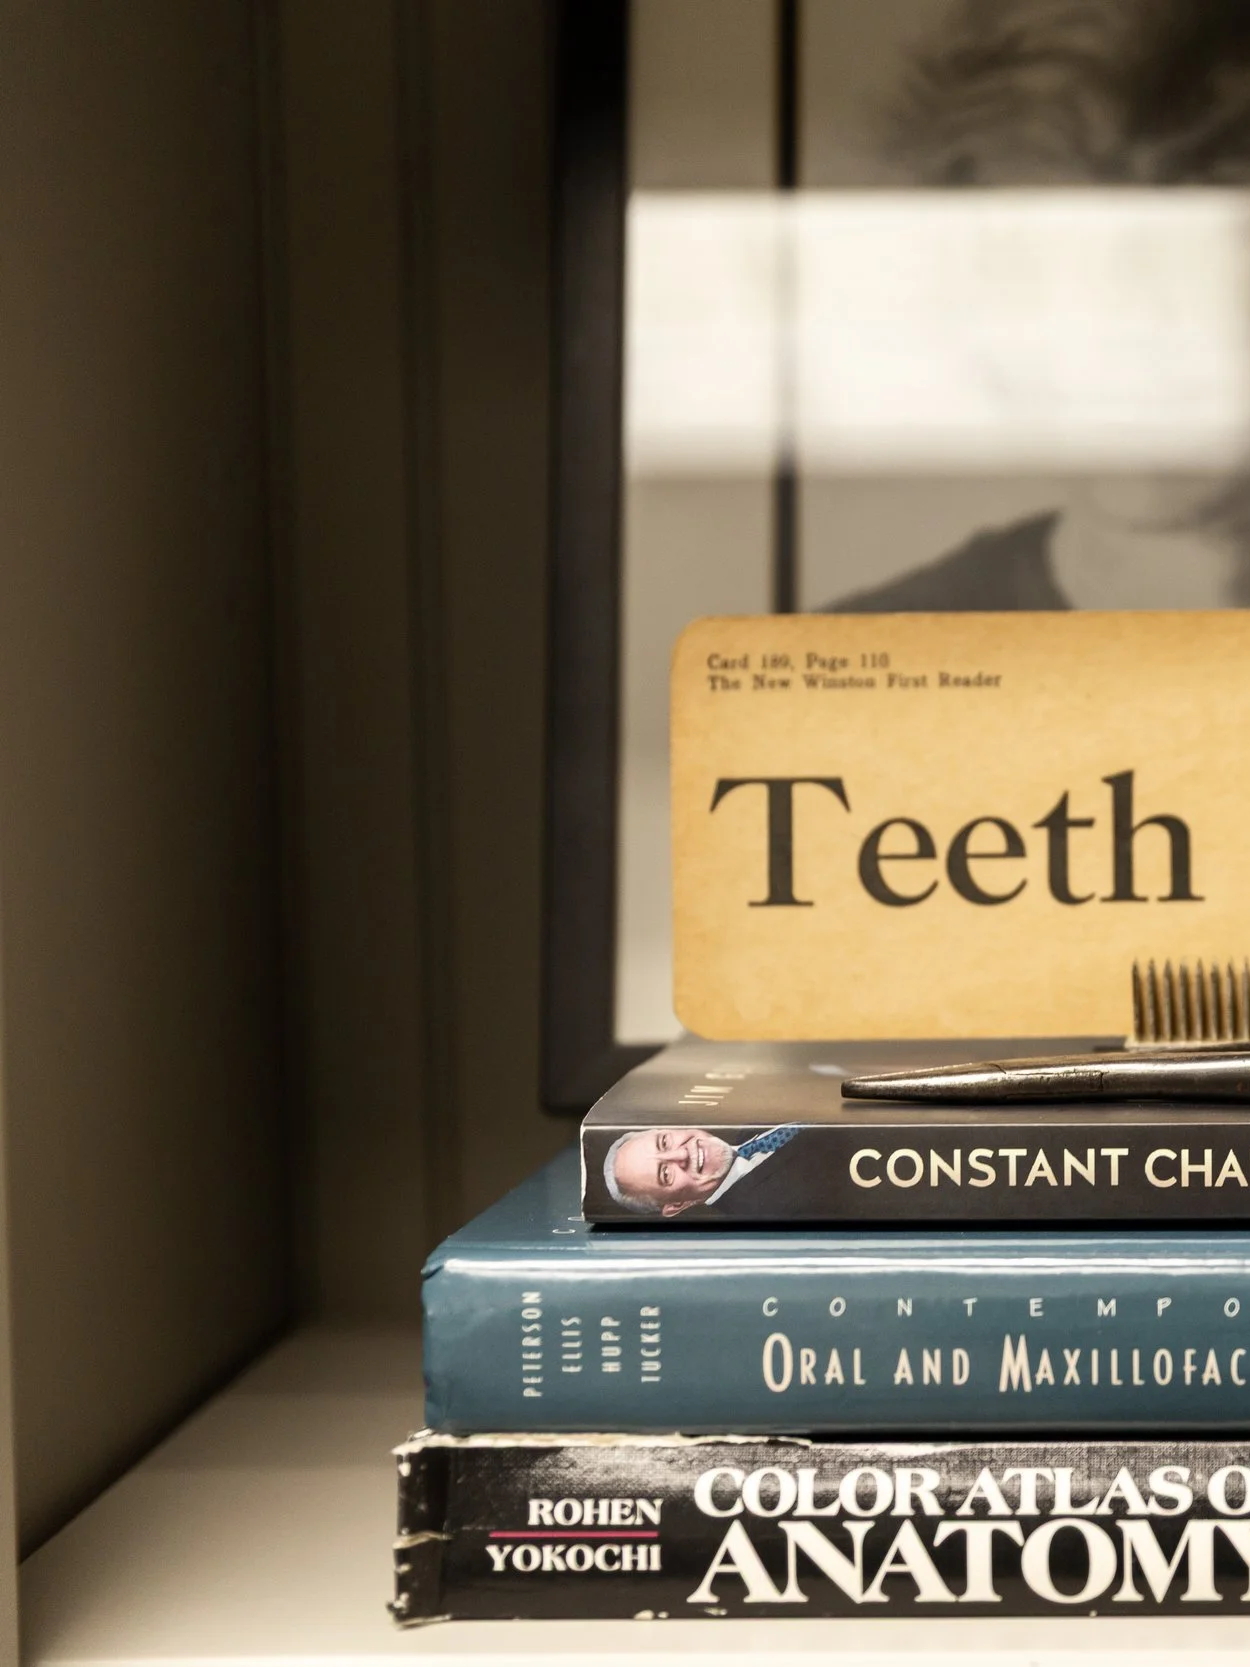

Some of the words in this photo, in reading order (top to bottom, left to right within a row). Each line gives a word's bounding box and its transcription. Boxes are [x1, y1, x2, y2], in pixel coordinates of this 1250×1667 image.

[706, 653, 749, 670] Card
[805, 652, 849, 670] Page
[707, 674, 741, 691] The
[752, 674, 791, 691] New
[803, 673, 876, 690] Winston
[887, 673, 927, 689] First
[938, 671, 1003, 688] Reader
[710, 770, 1205, 907] Teeth
[849, 1147, 1129, 1188] CONSTANT
[521, 1291, 543, 1397] PETERSON
[561, 1316, 582, 1373] ELLIS
[600, 1316, 622, 1372] HUPP
[640, 1306, 661, 1383] TUCKER
[894, 1347, 971, 1386] AND
[528, 1499, 663, 1526] ROHEN
[694, 1467, 944, 1518] COLOR
[957, 1466, 1194, 1516] ATLAS
[485, 1544, 661, 1572] YOKOCHI
